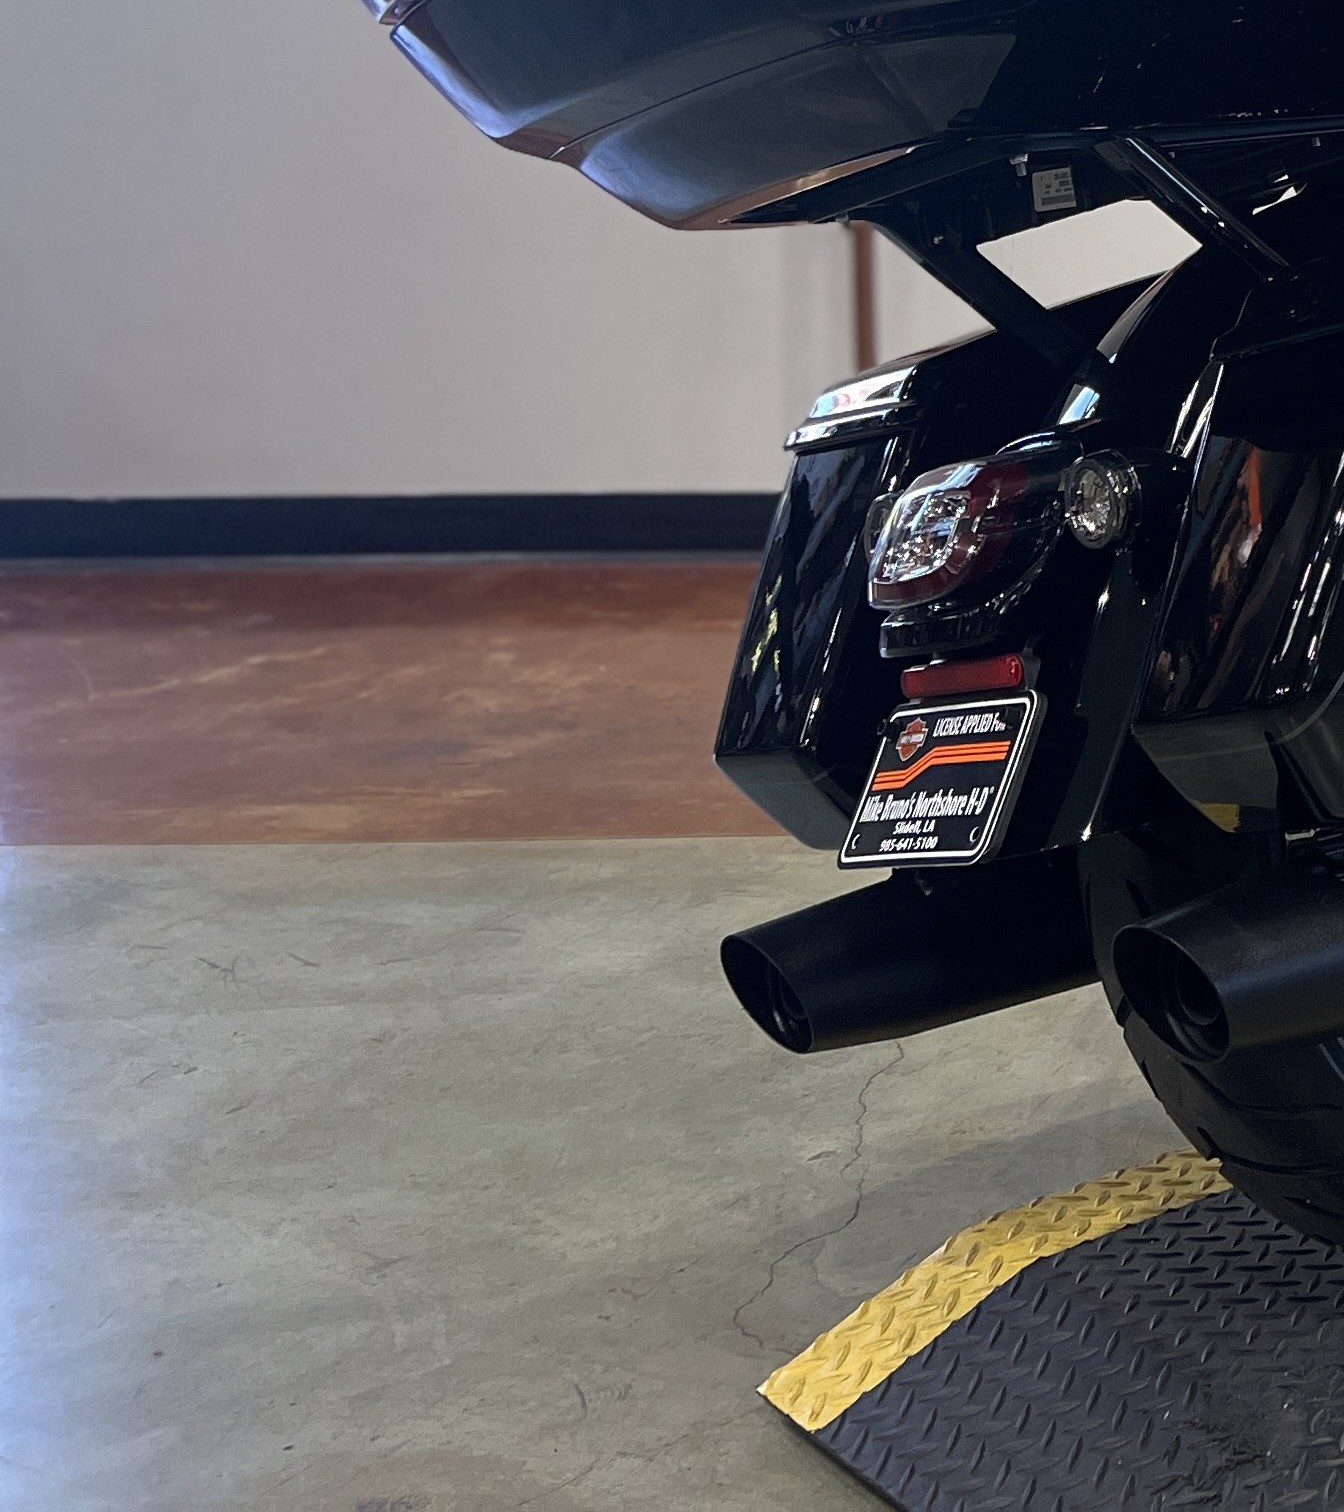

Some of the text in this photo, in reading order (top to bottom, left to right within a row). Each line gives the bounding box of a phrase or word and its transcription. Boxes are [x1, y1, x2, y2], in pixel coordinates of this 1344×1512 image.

[933, 717, 965, 738] LICENSE
[959, 713, 994, 735] APPLIED
[860, 794, 882, 823] Mike
[879, 792, 915, 821] Bruno's
[913, 788, 967, 818] Northshore
[923, 819, 936, 833] LA
[878, 835, 939, 853] 985-641-5100
